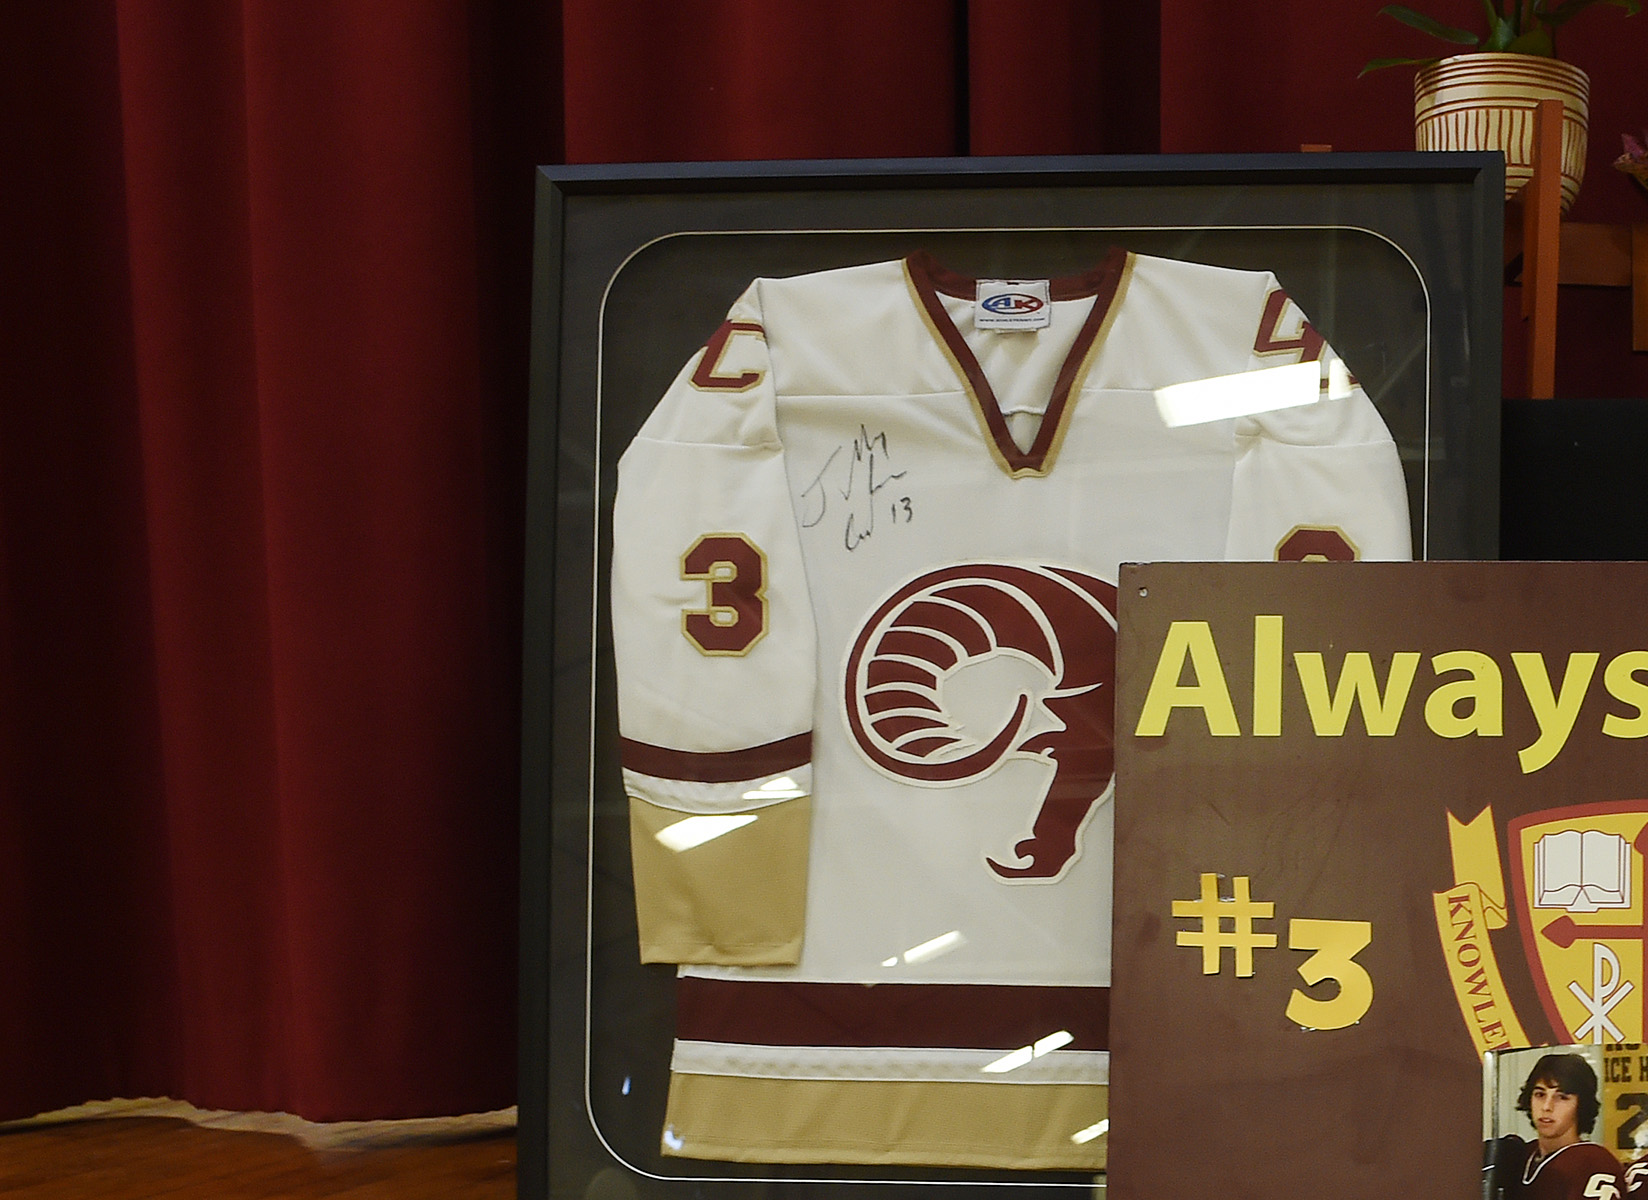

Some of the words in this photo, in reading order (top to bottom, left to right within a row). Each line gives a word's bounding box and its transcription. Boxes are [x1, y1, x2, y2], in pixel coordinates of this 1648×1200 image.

[891, 497, 913, 523] 13
[680, 533, 769, 658] 3
[1172, 872, 1374, 1031] #3
[1448, 894, 1512, 1050] KNOWLE
[1603, 1056, 1632, 1083] ICE
